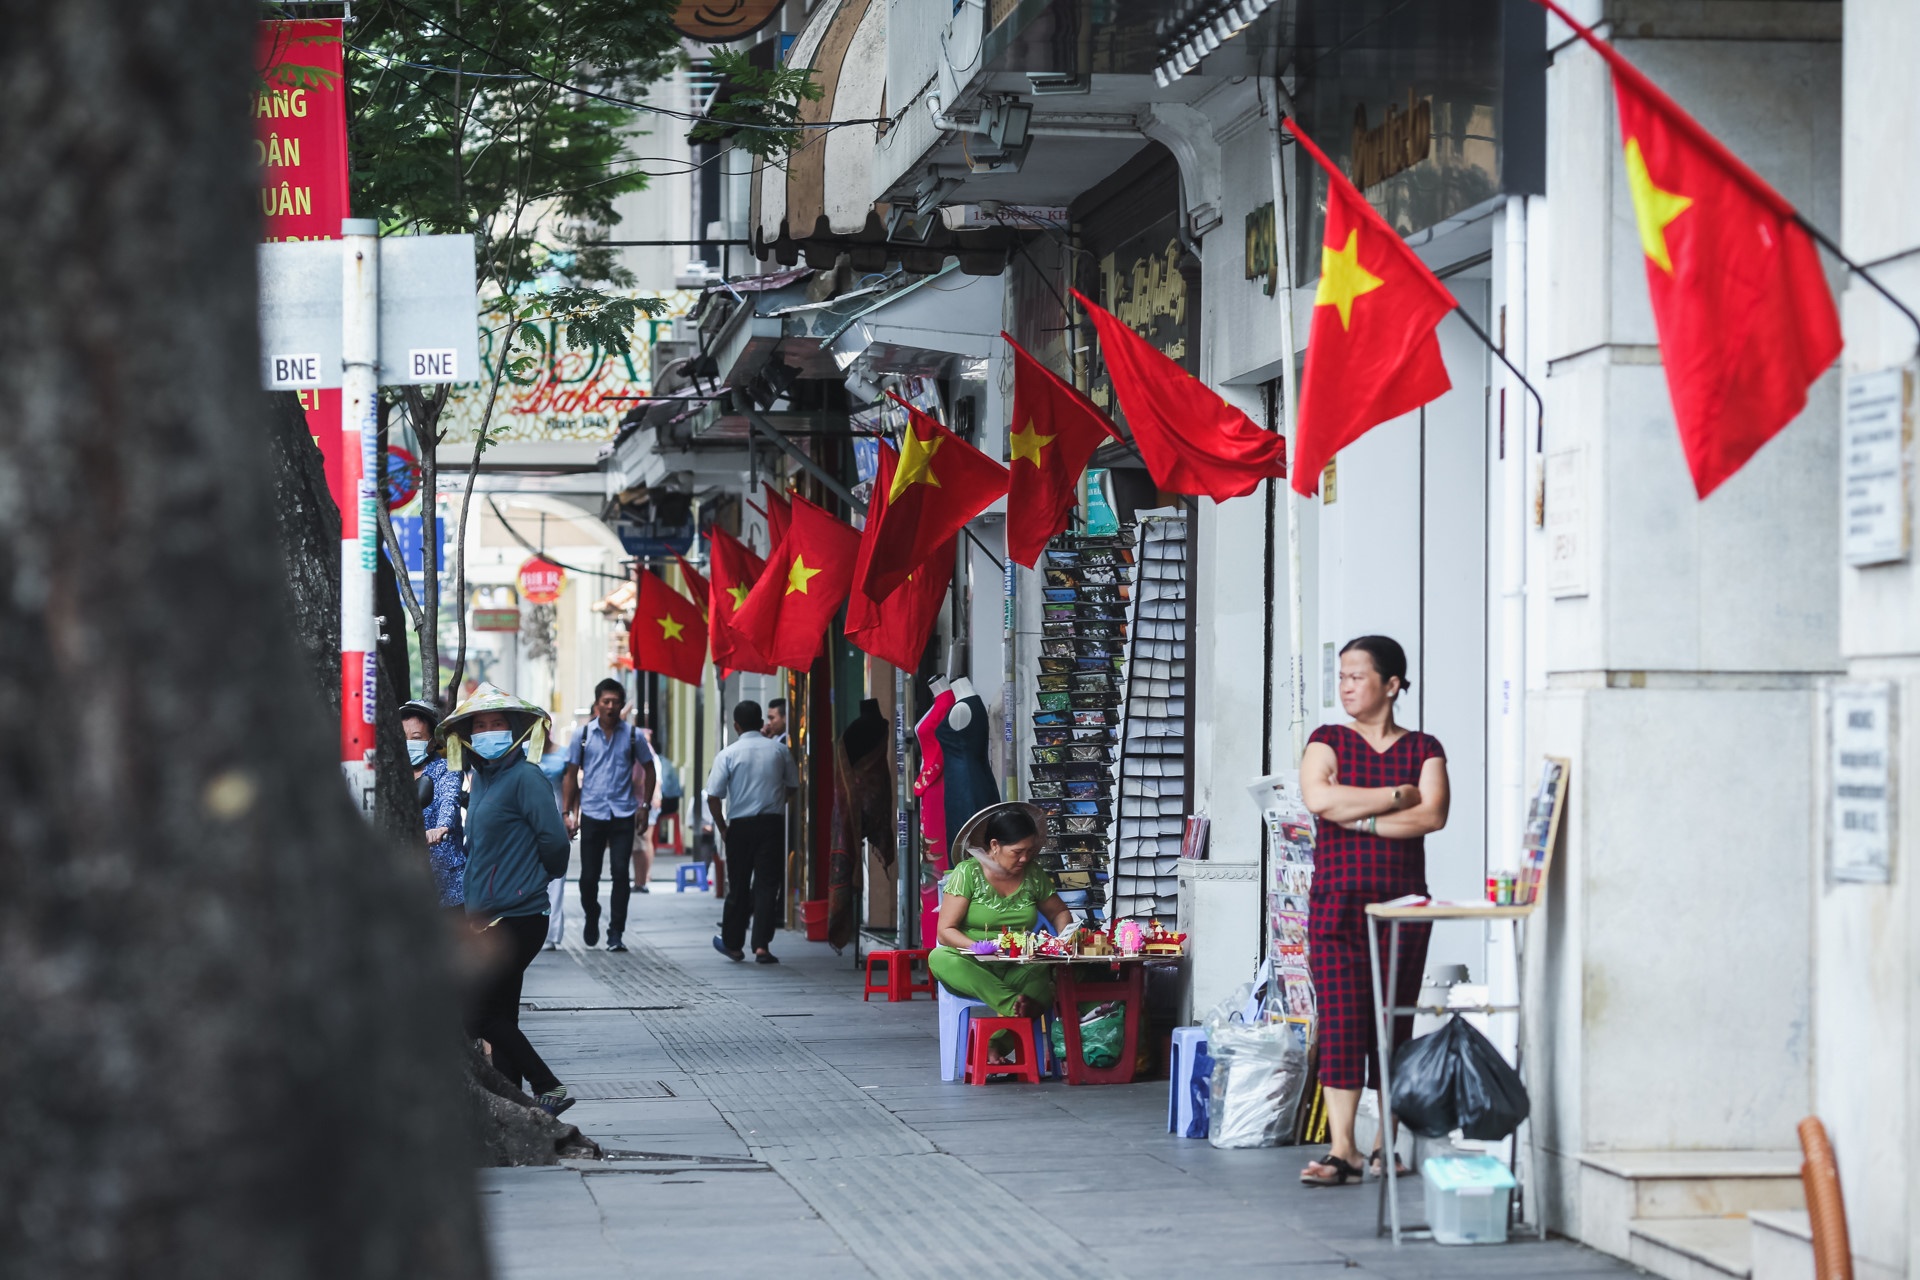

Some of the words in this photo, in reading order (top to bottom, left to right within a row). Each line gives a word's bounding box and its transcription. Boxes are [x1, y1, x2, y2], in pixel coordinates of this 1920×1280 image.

[262, 181, 312, 216] UÂN
[276, 358, 316, 381] BNE
[414, 354, 453, 375] BNE
